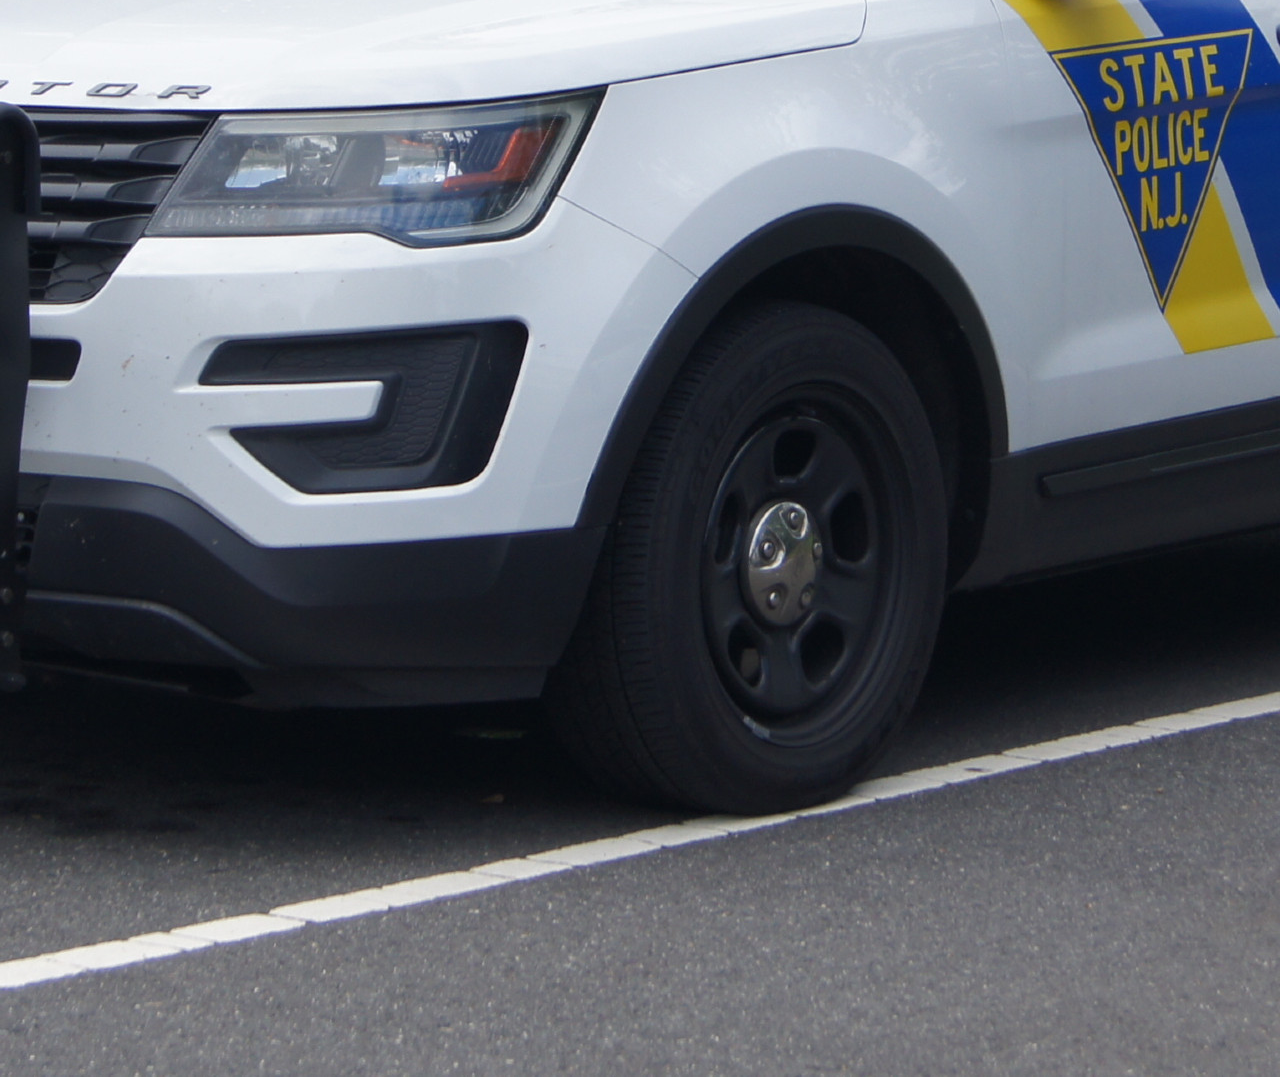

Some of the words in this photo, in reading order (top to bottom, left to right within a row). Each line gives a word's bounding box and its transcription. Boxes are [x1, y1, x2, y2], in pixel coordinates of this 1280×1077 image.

[1099, 44, 1224, 112] STATE
[1114, 107, 1210, 176] POLICE
[1140, 171, 1189, 232] N.J.
